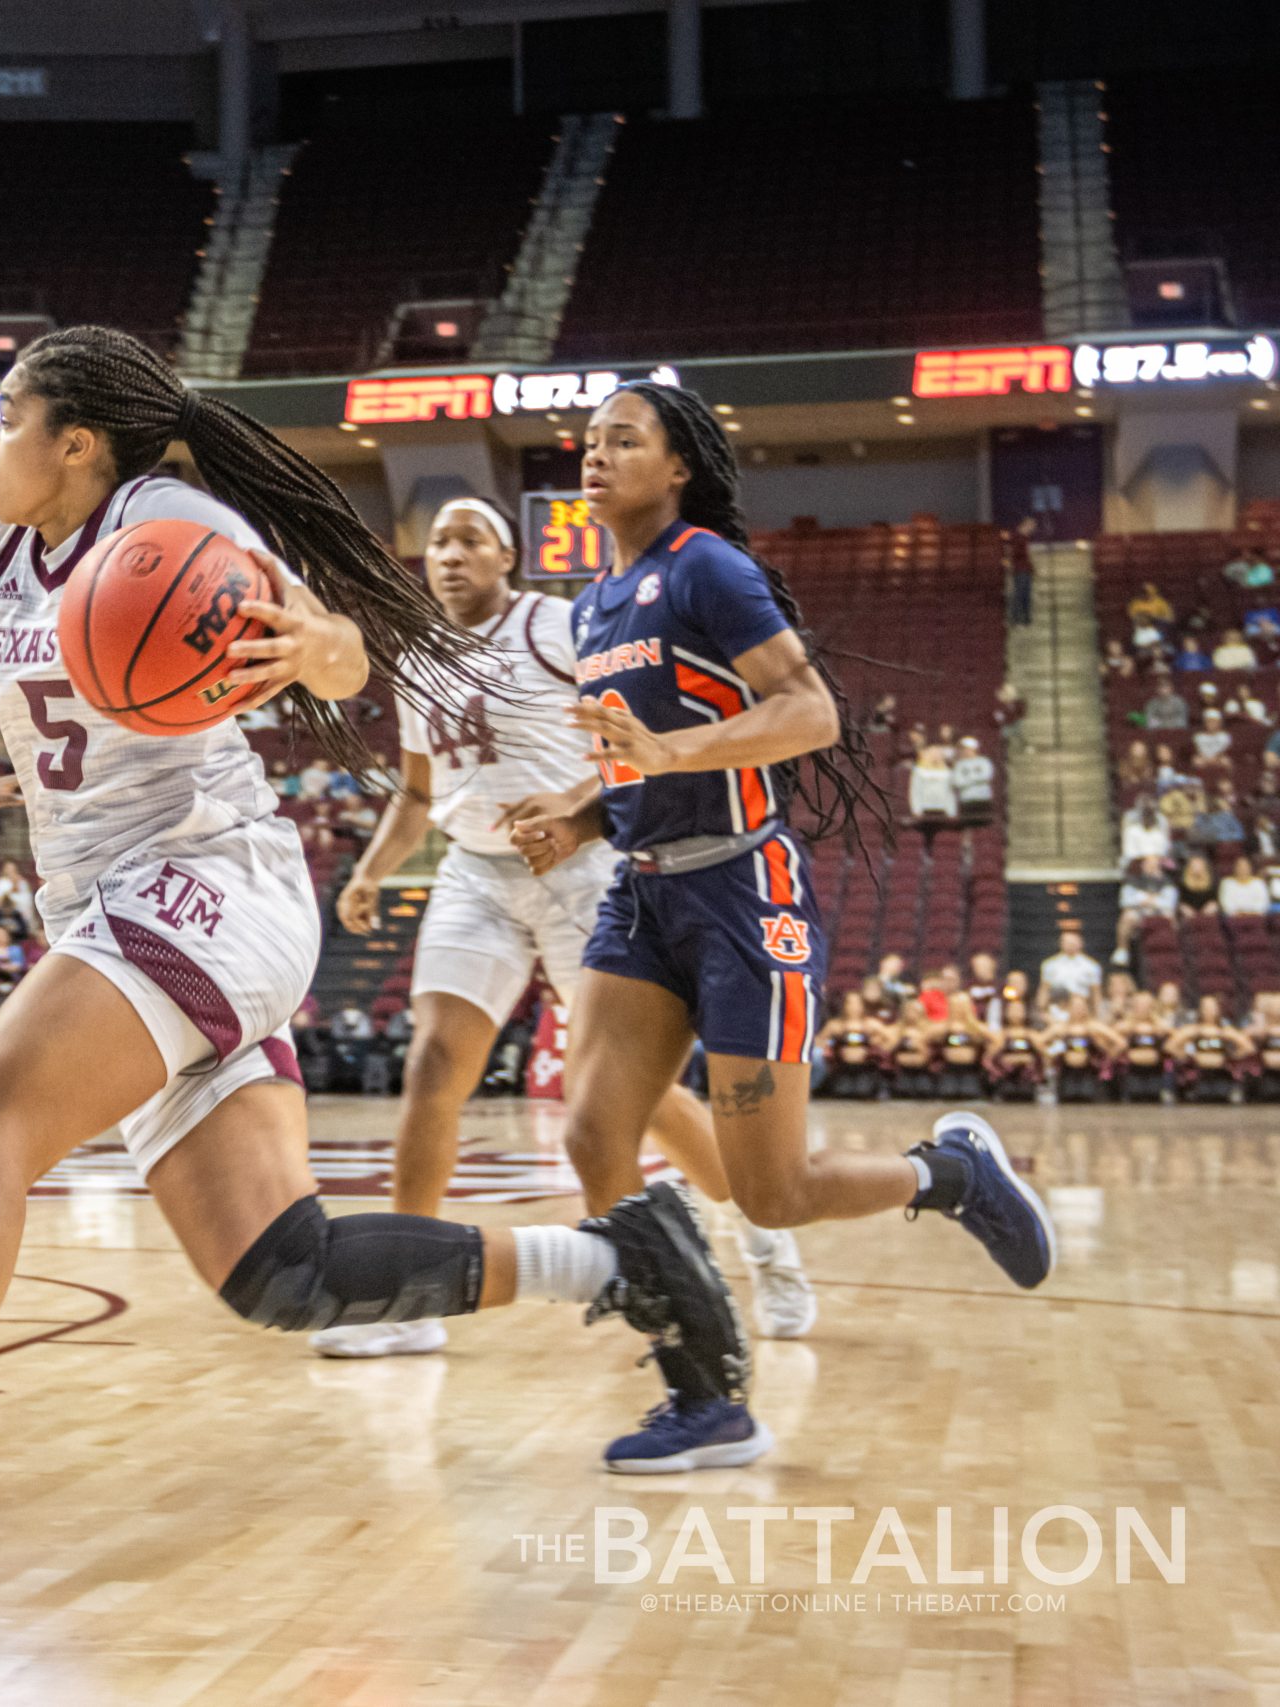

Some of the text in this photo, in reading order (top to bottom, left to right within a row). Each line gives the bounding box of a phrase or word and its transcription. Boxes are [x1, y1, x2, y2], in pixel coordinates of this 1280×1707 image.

[913, 346, 1070, 397] ESPN
[346, 374, 492, 424] ESPN
[540, 525, 599, 573] 21
[17, 679, 87, 791] 5
[428, 694, 498, 769] 44
